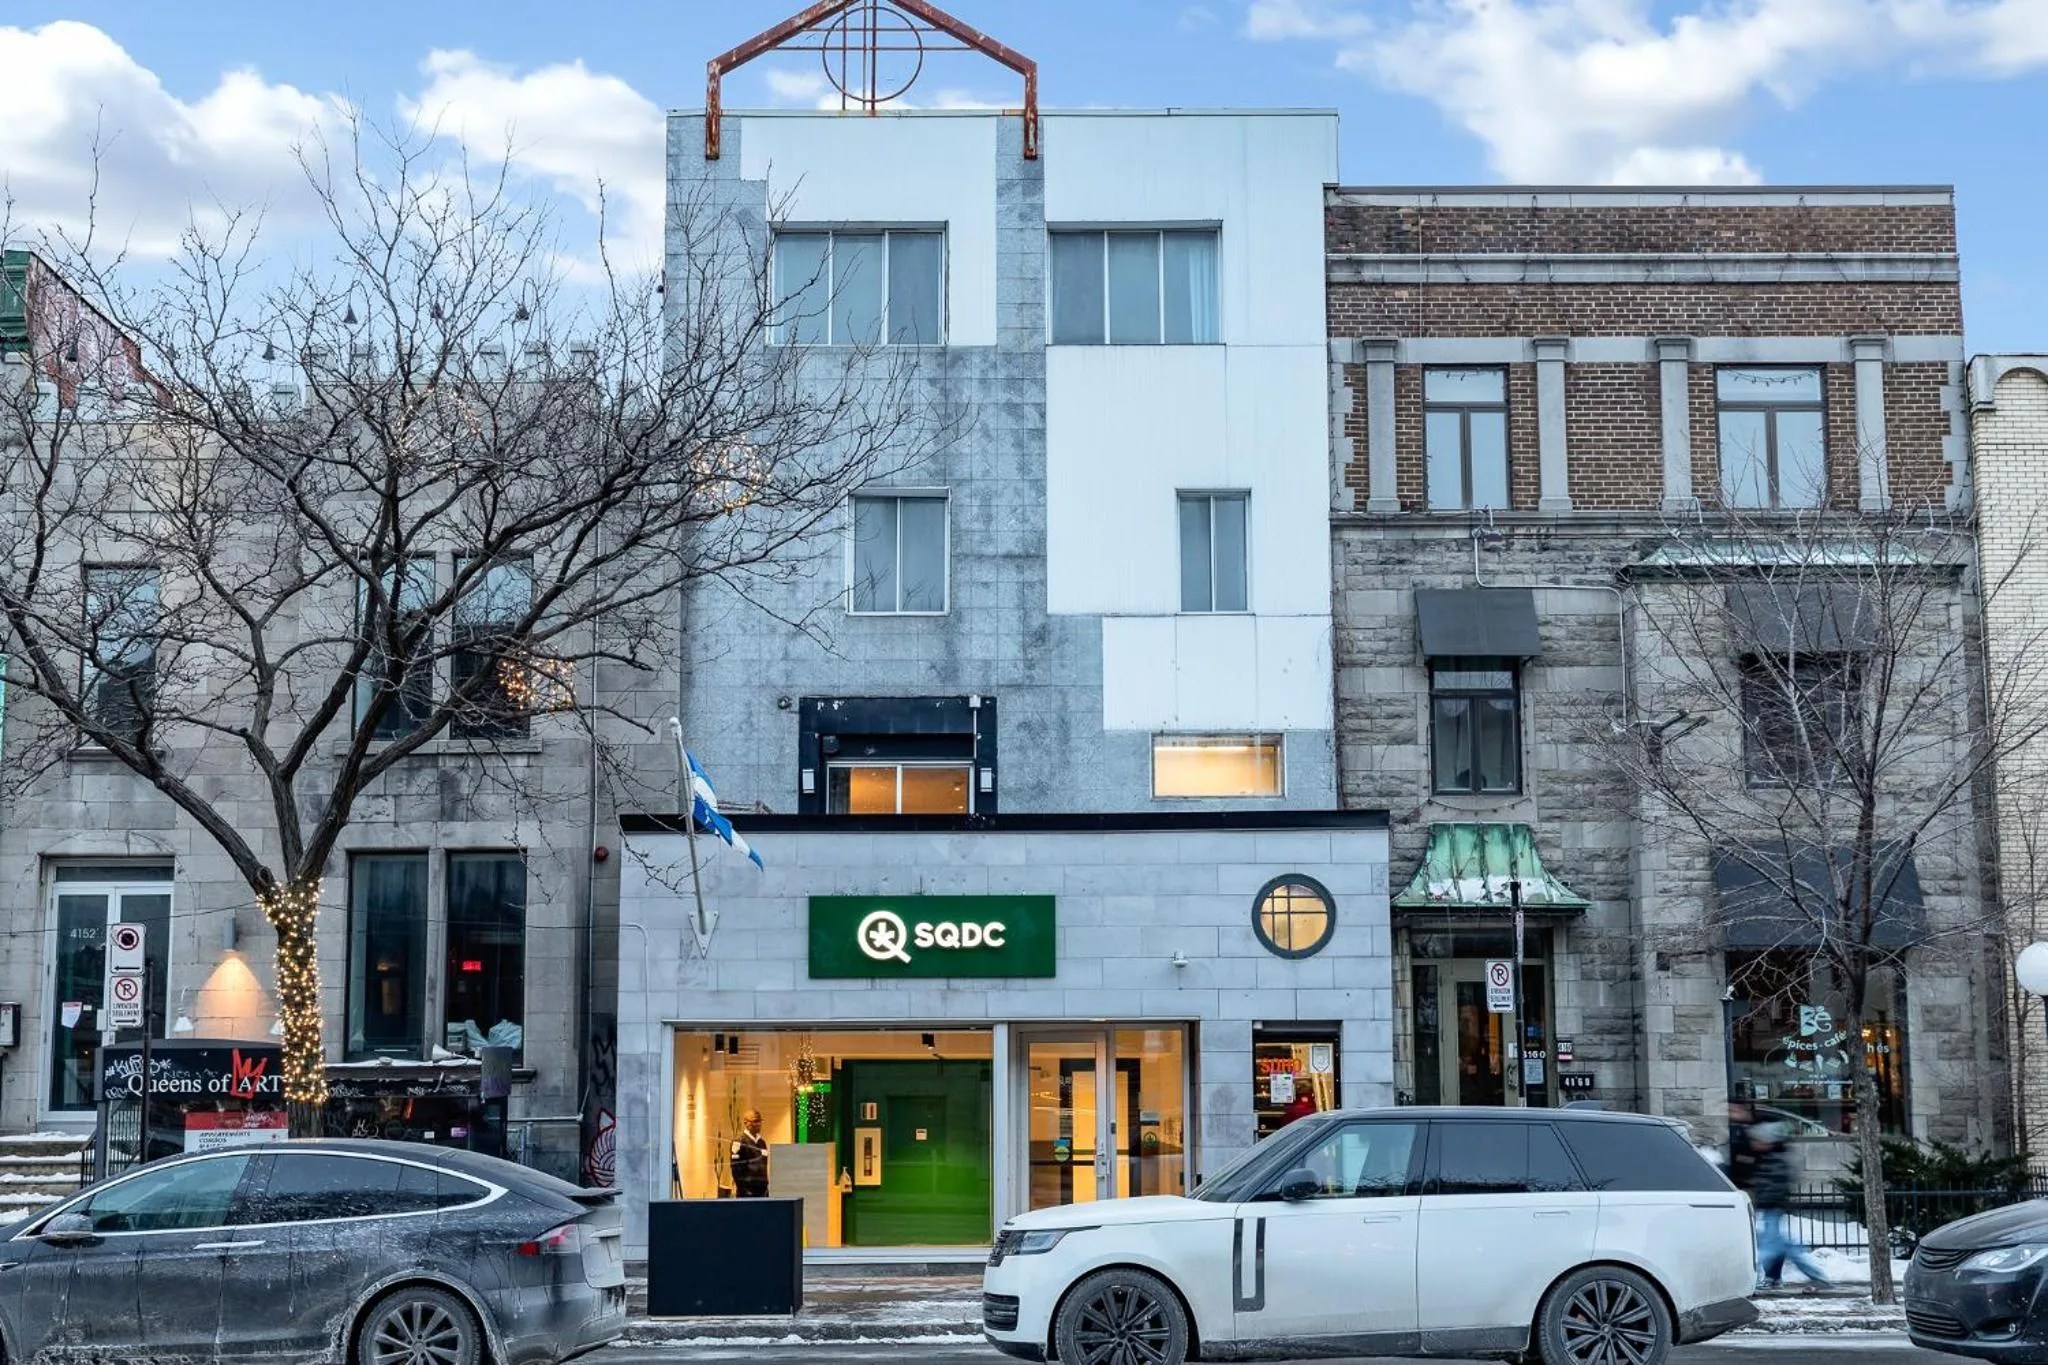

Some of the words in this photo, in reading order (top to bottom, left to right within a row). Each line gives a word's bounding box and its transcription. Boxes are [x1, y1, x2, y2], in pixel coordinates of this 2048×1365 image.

[70, 927, 97, 939] 4152
[914, 921, 1006, 949] SQDC
[208, 1073, 234, 1093] of
[238, 1074, 283, 1093] ART
